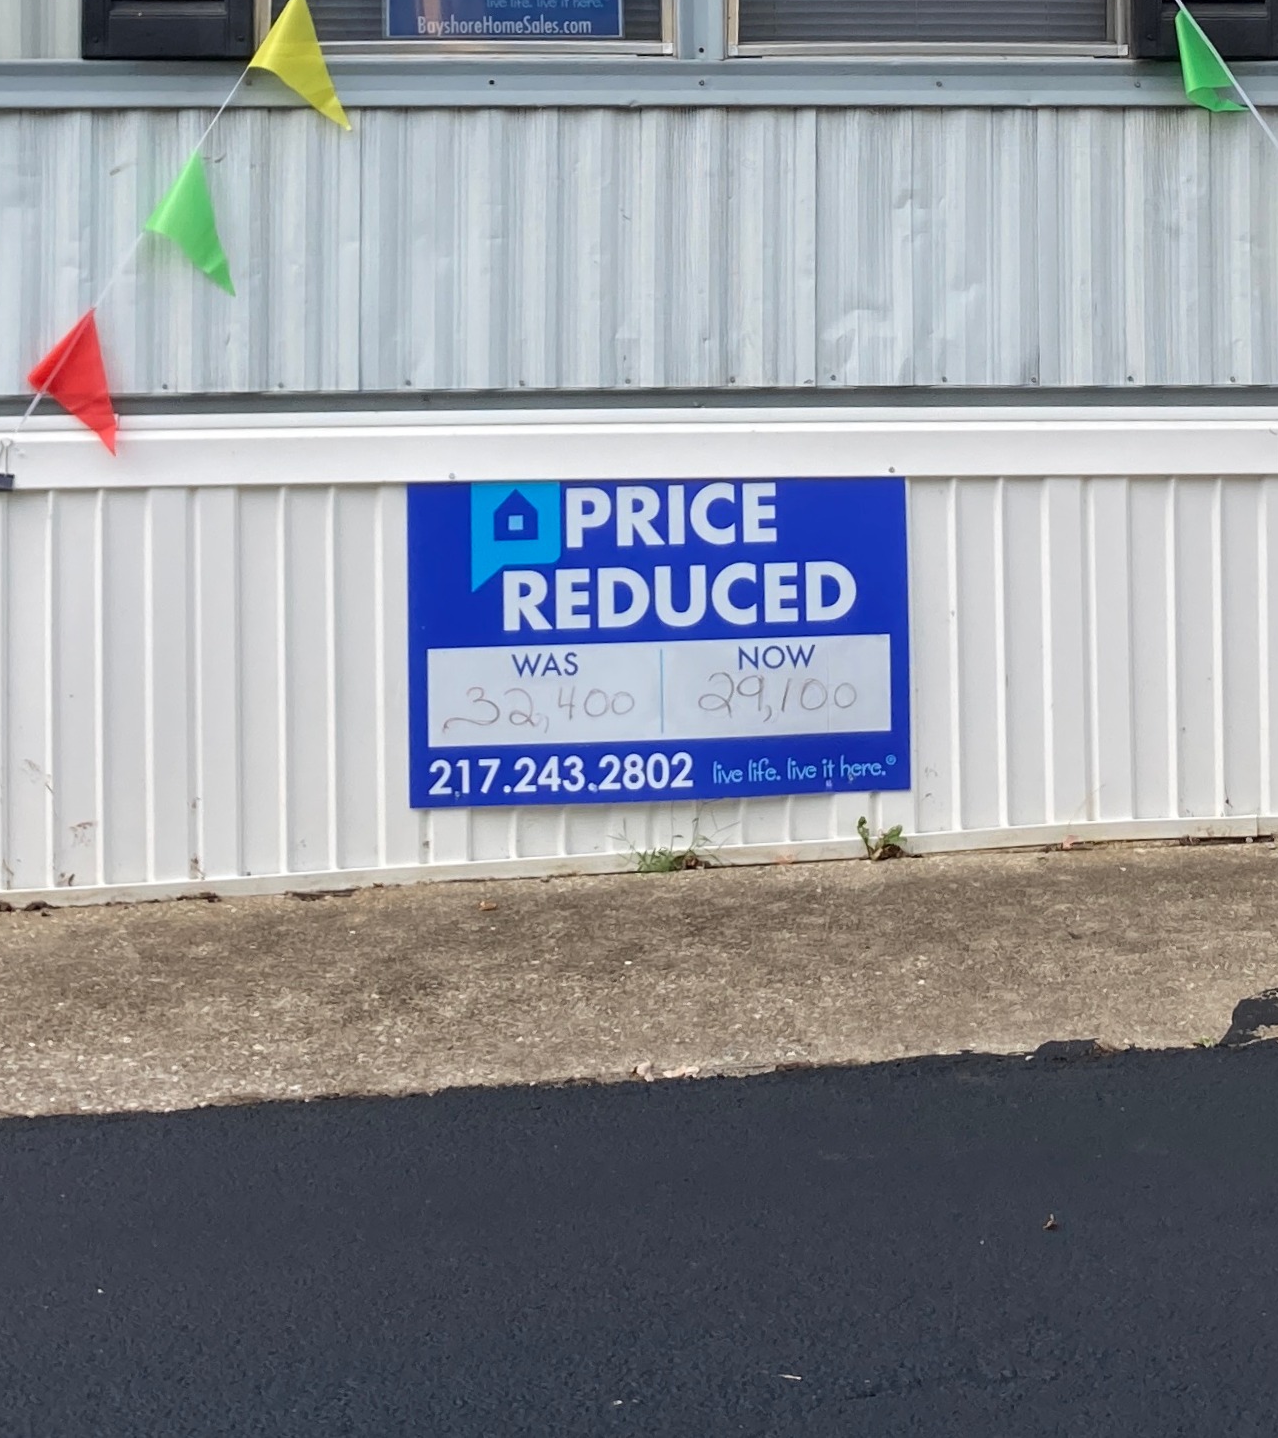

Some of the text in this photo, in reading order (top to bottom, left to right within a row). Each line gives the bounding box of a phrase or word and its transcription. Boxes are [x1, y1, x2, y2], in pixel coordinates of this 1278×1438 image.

[417, 14, 592, 37] BayshoreHomeSales.com
[565, 481, 778, 549] PRICE
[502, 560, 858, 632] REDUCED
[511, 652, 579, 677] WAS
[738, 644, 816, 671] NOW
[428, 751, 694, 796] 217.243.2802
[712, 761, 743, 784] live
[748, 757, 782, 782] life.
[787, 757, 817, 780] live
[821, 759, 835, 778] it
